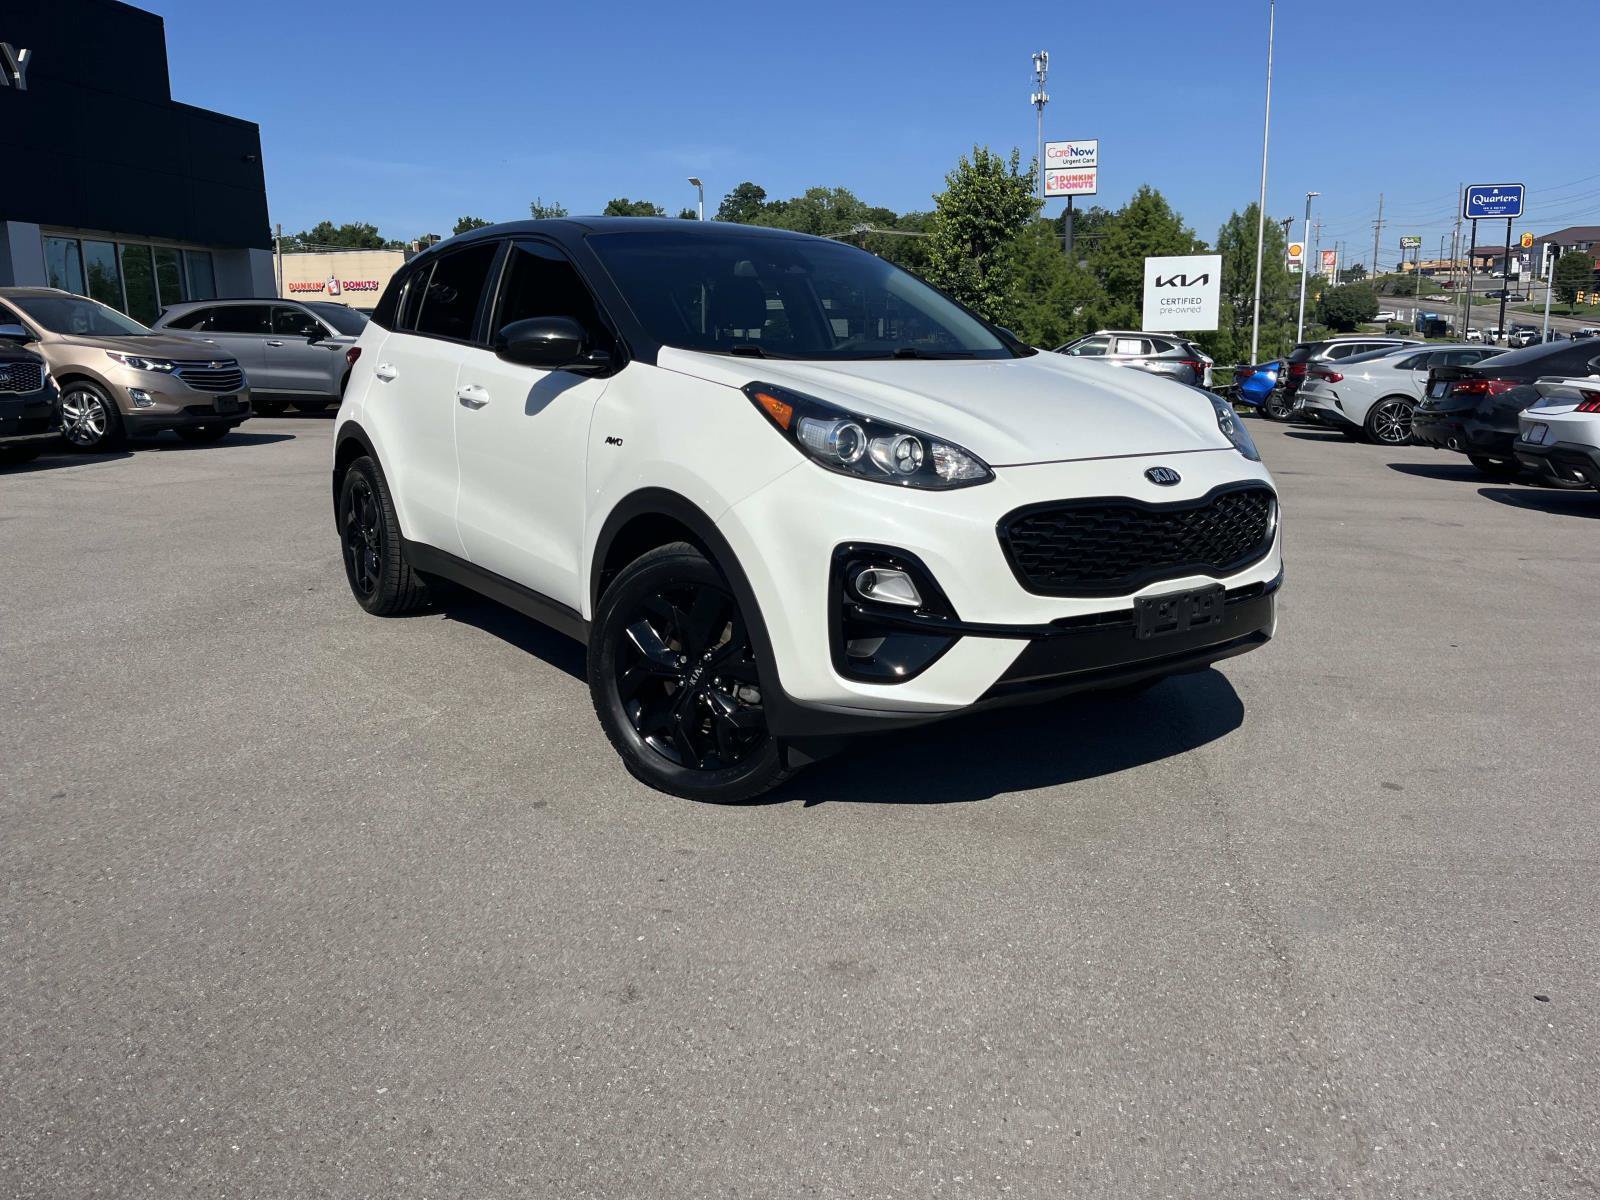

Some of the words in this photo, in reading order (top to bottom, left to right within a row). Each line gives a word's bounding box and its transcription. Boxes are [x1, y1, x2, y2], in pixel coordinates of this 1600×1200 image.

[1048, 146, 1095, 158] CareNow
[1060, 181, 1094, 189] DONUTS
[1472, 194, 1518, 206] Quarters
[343, 281, 379, 291] DONUTS
[1155, 274, 1209, 287] KIA
[1160, 297, 1202, 306] CERTIFIED
[1160, 306, 1201, 316] pre-owned
[1149, 469, 1180, 482] KIA
